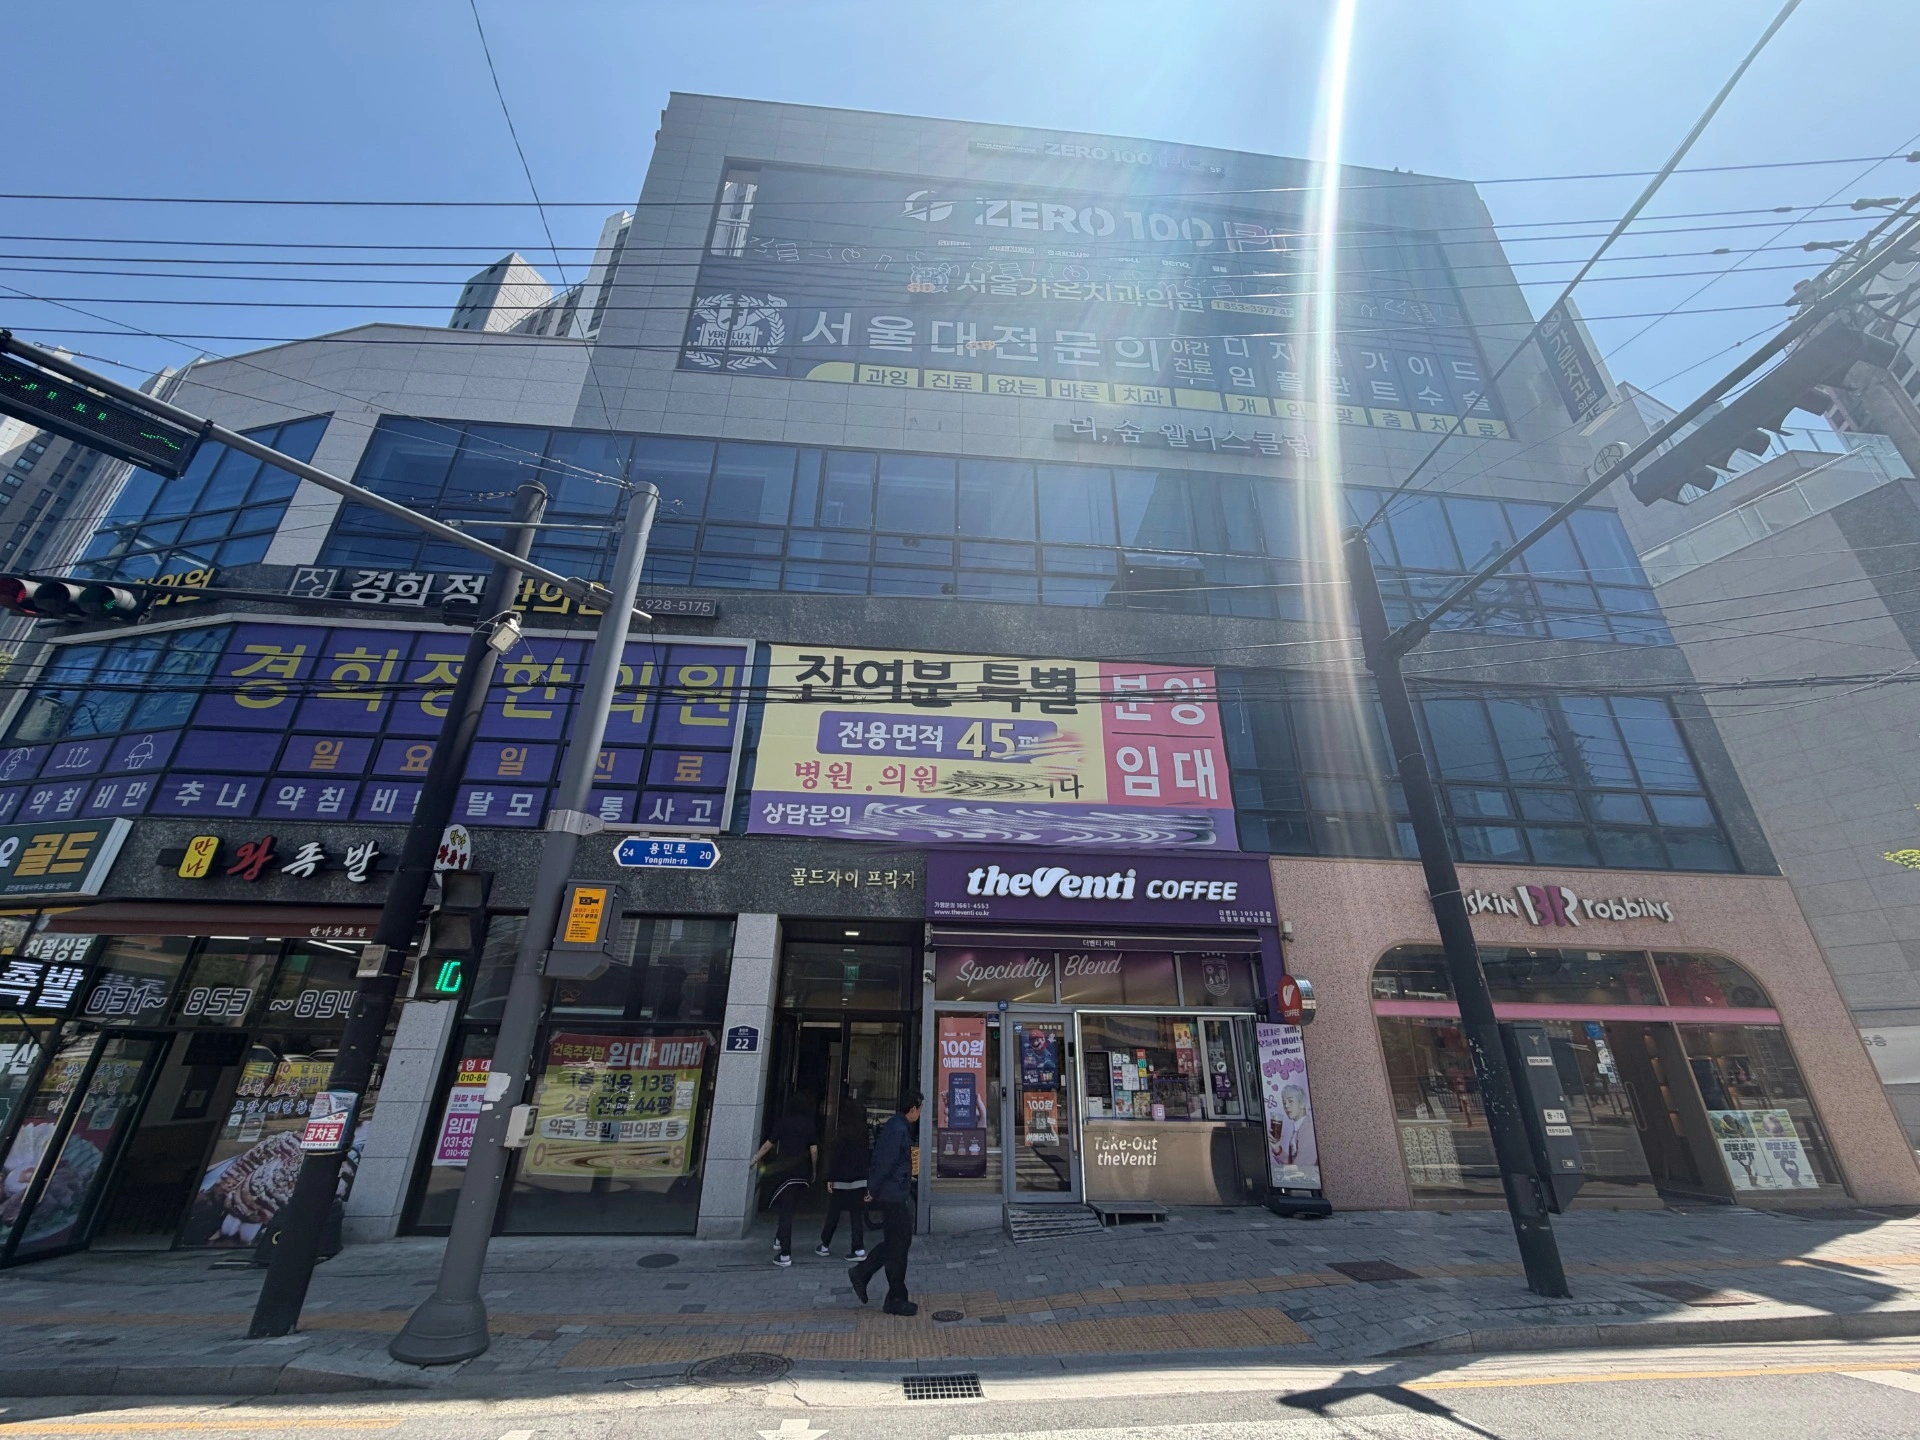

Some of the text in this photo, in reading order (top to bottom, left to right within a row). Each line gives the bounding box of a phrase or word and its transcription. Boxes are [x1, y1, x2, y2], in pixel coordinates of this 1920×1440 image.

[1044, 143, 1106, 161] ZERO
[1108, 150, 1152, 165] 100
[974, 196, 1116, 236] ZERO
[1123, 210, 1214, 246] 100
[957, 271, 1204, 313] 서울가온치과의원
[1224, 302, 1277, 314] 853-3377
[707, 339, 726, 347] TAS
[731, 331, 752, 340] LUX
[1170, 337, 1210, 356] 야간
[1173, 357, 1213, 375] 진료
[867, 369, 909, 386] 과잉
[932, 373, 973, 391] 진료
[997, 377, 1039, 395] 없는
[1059, 384, 1100, 400] 바른
[1124, 387, 1163, 405] 치과
[1158, 423, 1311, 458] 웰니스클럽
[795, 654, 1079, 715] 잔여분 특별
[1111, 673, 1208, 726] 분양
[837, 720, 944, 753] 전용면적
[1116, 745, 1218, 800] 임대
[29, 781, 147, 815] 약침 비만
[276, 784, 346, 813] 약침
[762, 802, 852, 826] 상담문의
[13, 831, 99, 877] 골드
[621, 843, 712, 860] 24 용민로 20
[644, 856, 688, 866] Yongmin-ro
[791, 867, 918, 890] 골드자이 프라자
[966, 864, 1238, 902] theVenti COFFEE
[1082, 939, 1116, 948] 더벤티 커피
[955, 952, 1123, 988] Specialty Blend
[1284, 1008, 1300, 1017] COFFEE
[553, 1042, 606, 1060] 건축주직접
[734, 1038, 749, 1050] 22
[940, 1039, 985, 1056] 100원
[942, 1057, 983, 1069] 아메리카노
[601, 1073, 633, 1093] 전용
[641, 1073, 676, 1093] 13평
[1026, 1099, 1054, 1110] 100원
[305, 1127, 339, 1141] 교차로
[448, 1117, 479, 1134] 임대
[549, 1118, 680, 1140] 약국, 병원, 편의점 등
[1094, 1136, 1159, 1151] Take-Out
[1097, 1151, 1158, 1167] theVenti
